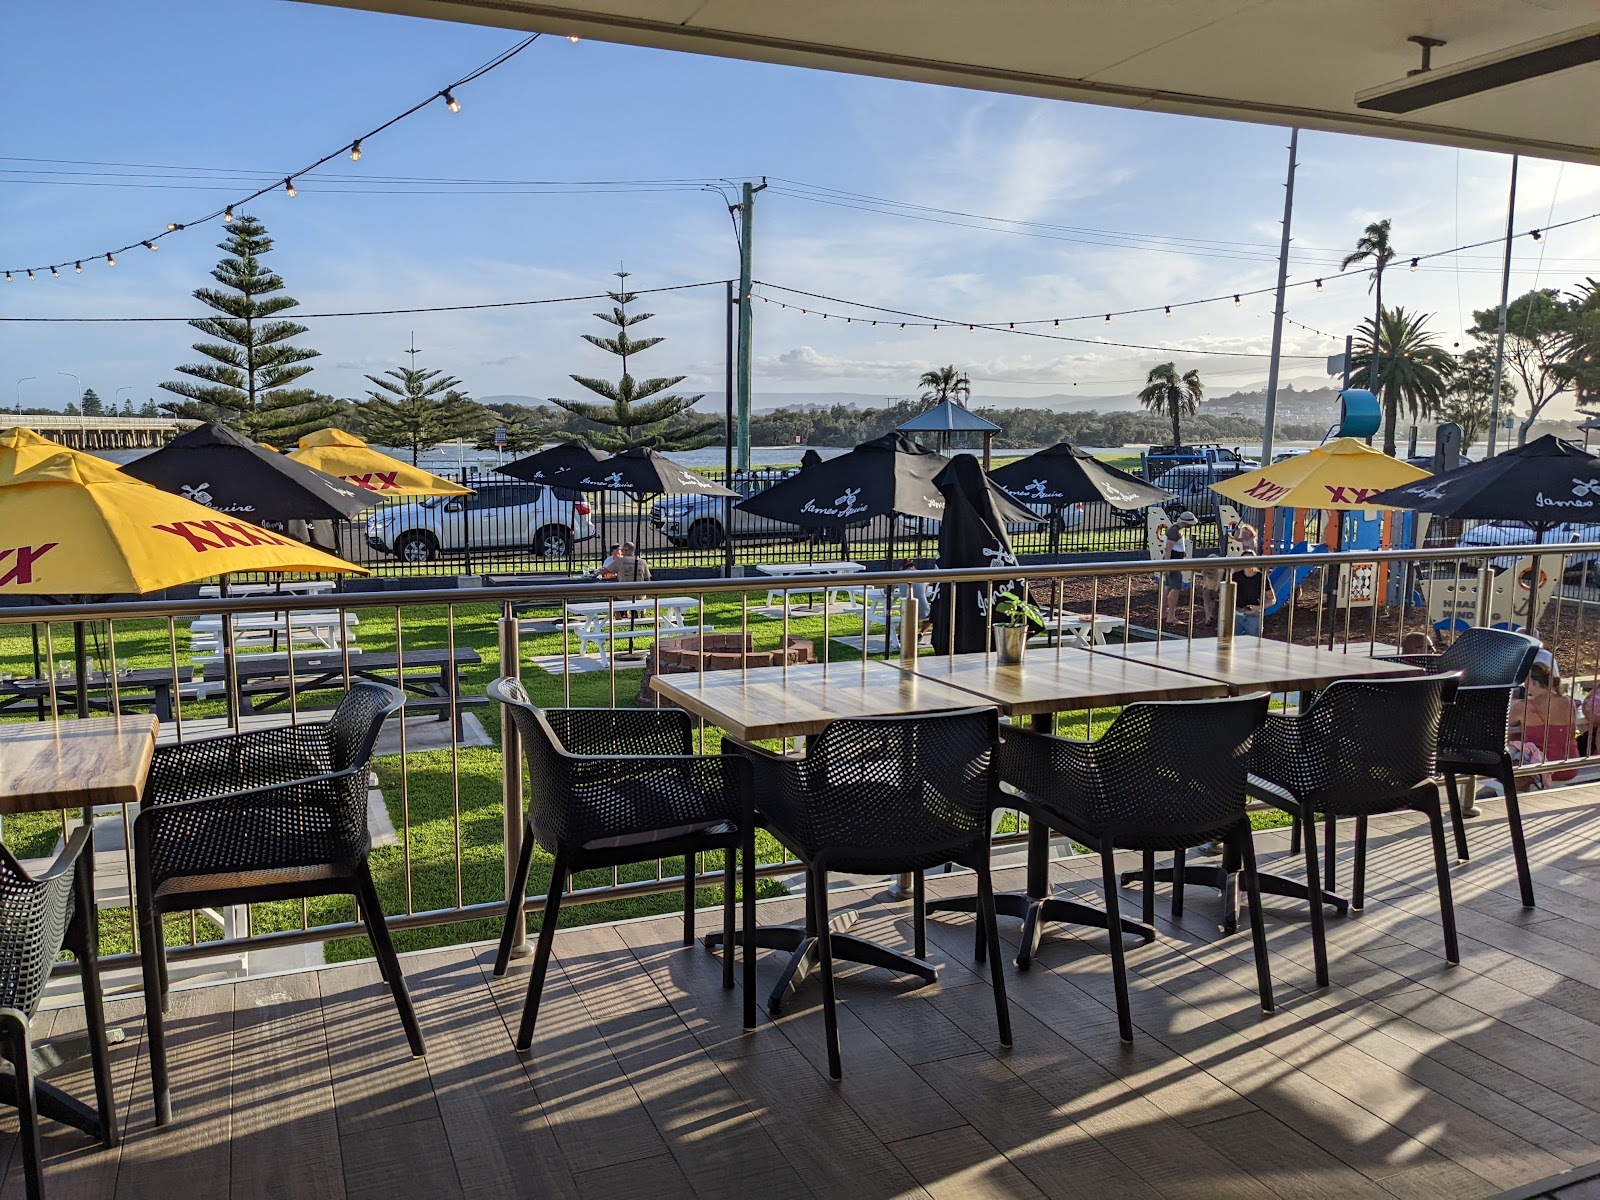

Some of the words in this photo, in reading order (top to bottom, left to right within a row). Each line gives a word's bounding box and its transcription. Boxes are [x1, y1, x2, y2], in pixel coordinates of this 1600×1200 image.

[338, 471, 402, 491] XX
[800, 498, 838, 515] James
[837, 503, 869, 518] Squire
[1536, 491, 1594, 508] James
[152, 519, 299, 553] XXXX
